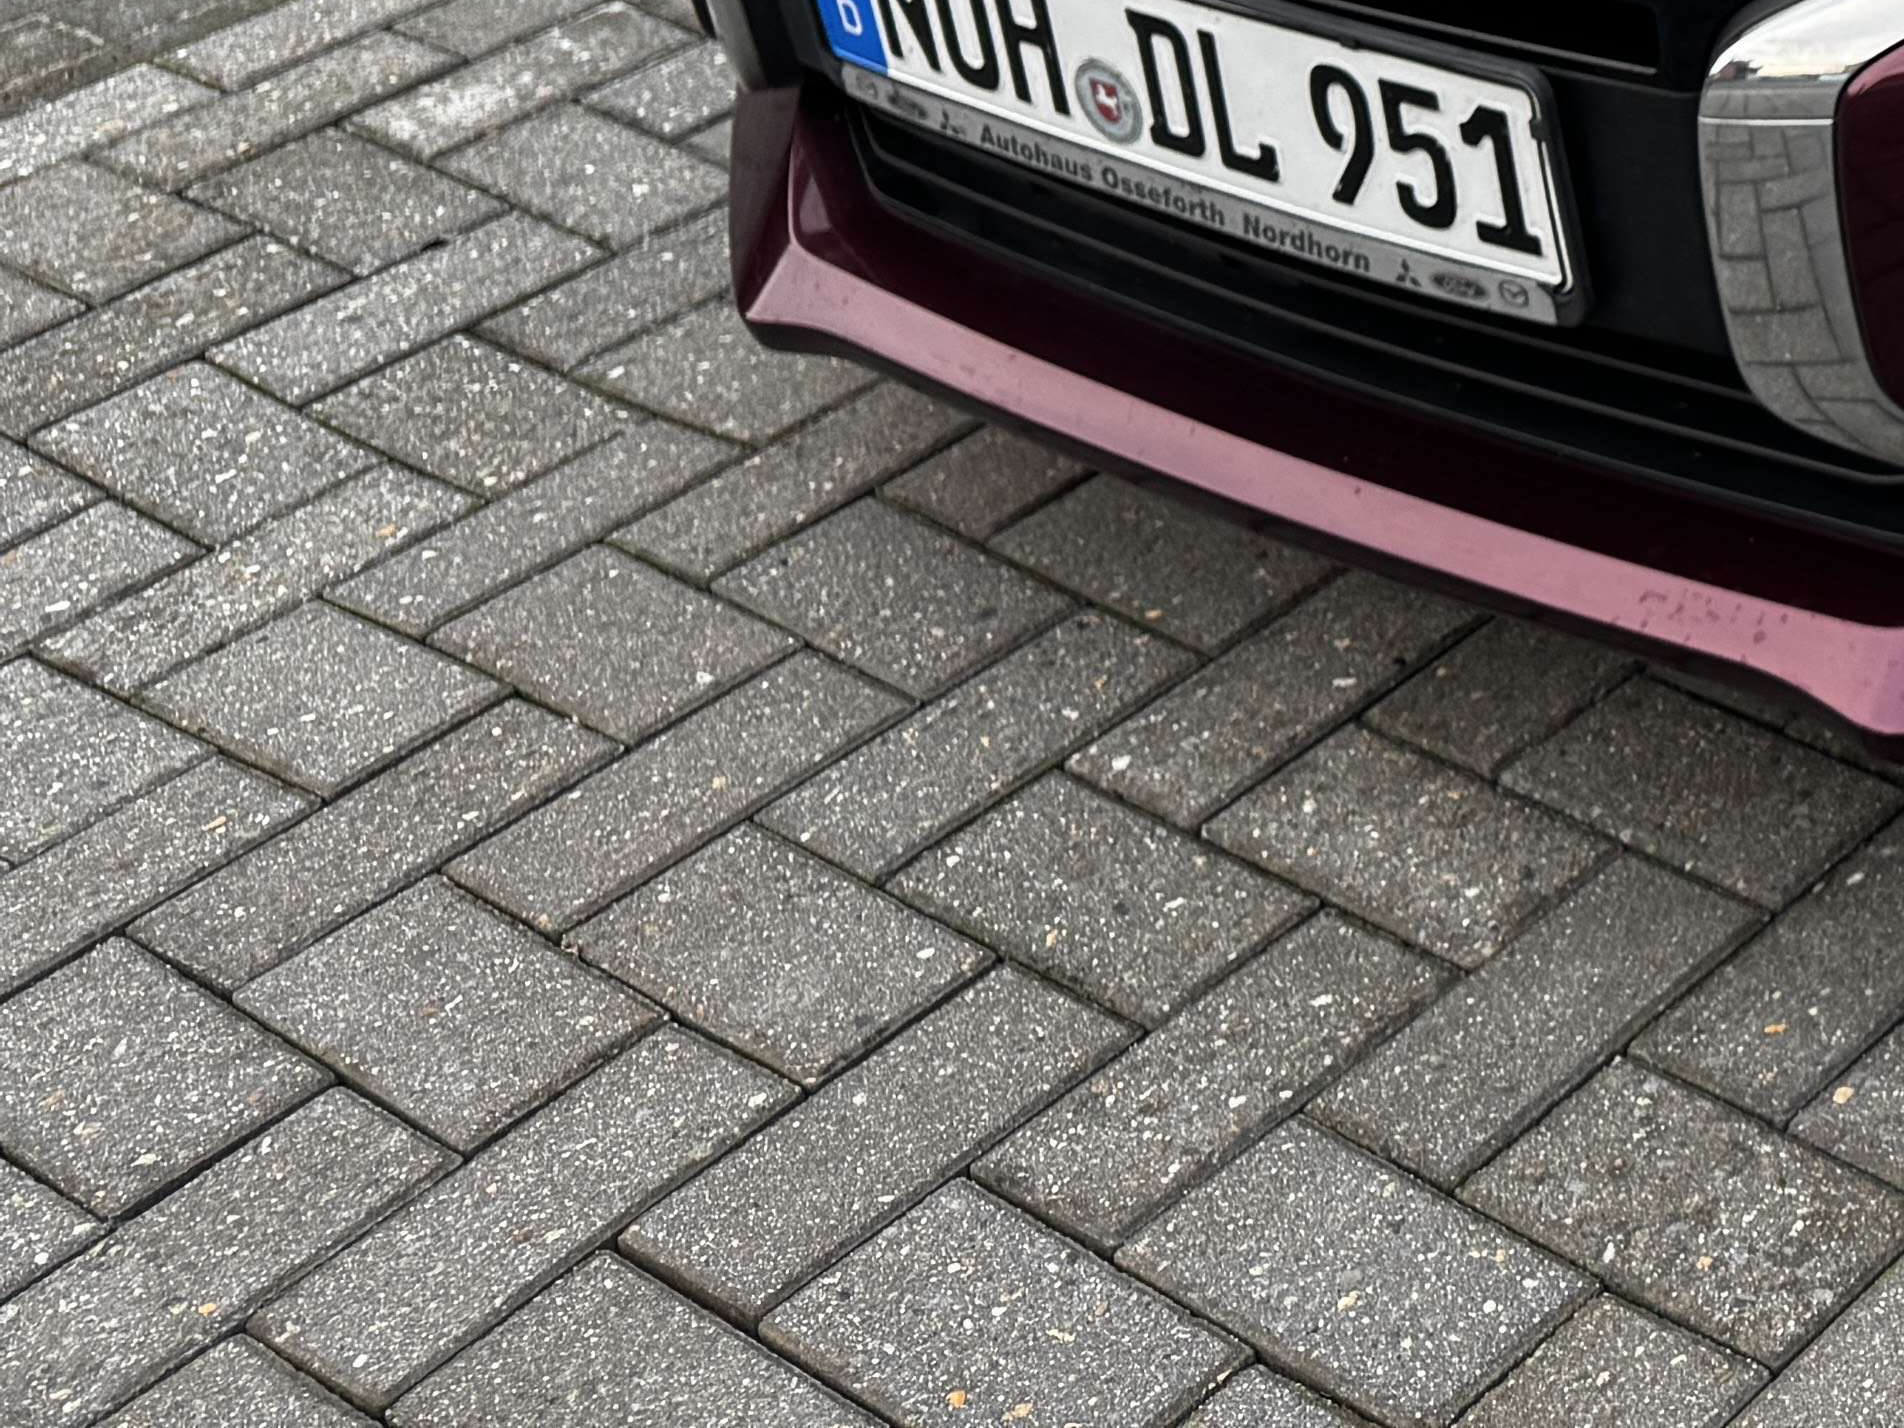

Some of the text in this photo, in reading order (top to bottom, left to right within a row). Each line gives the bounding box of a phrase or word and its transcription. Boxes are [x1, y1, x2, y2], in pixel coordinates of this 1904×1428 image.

[980, 122, 1371, 273] Autohaus Osseforth Nordhorn
[1124, 8, 1279, 182] DL
[1309, 64, 1543, 257] 951
